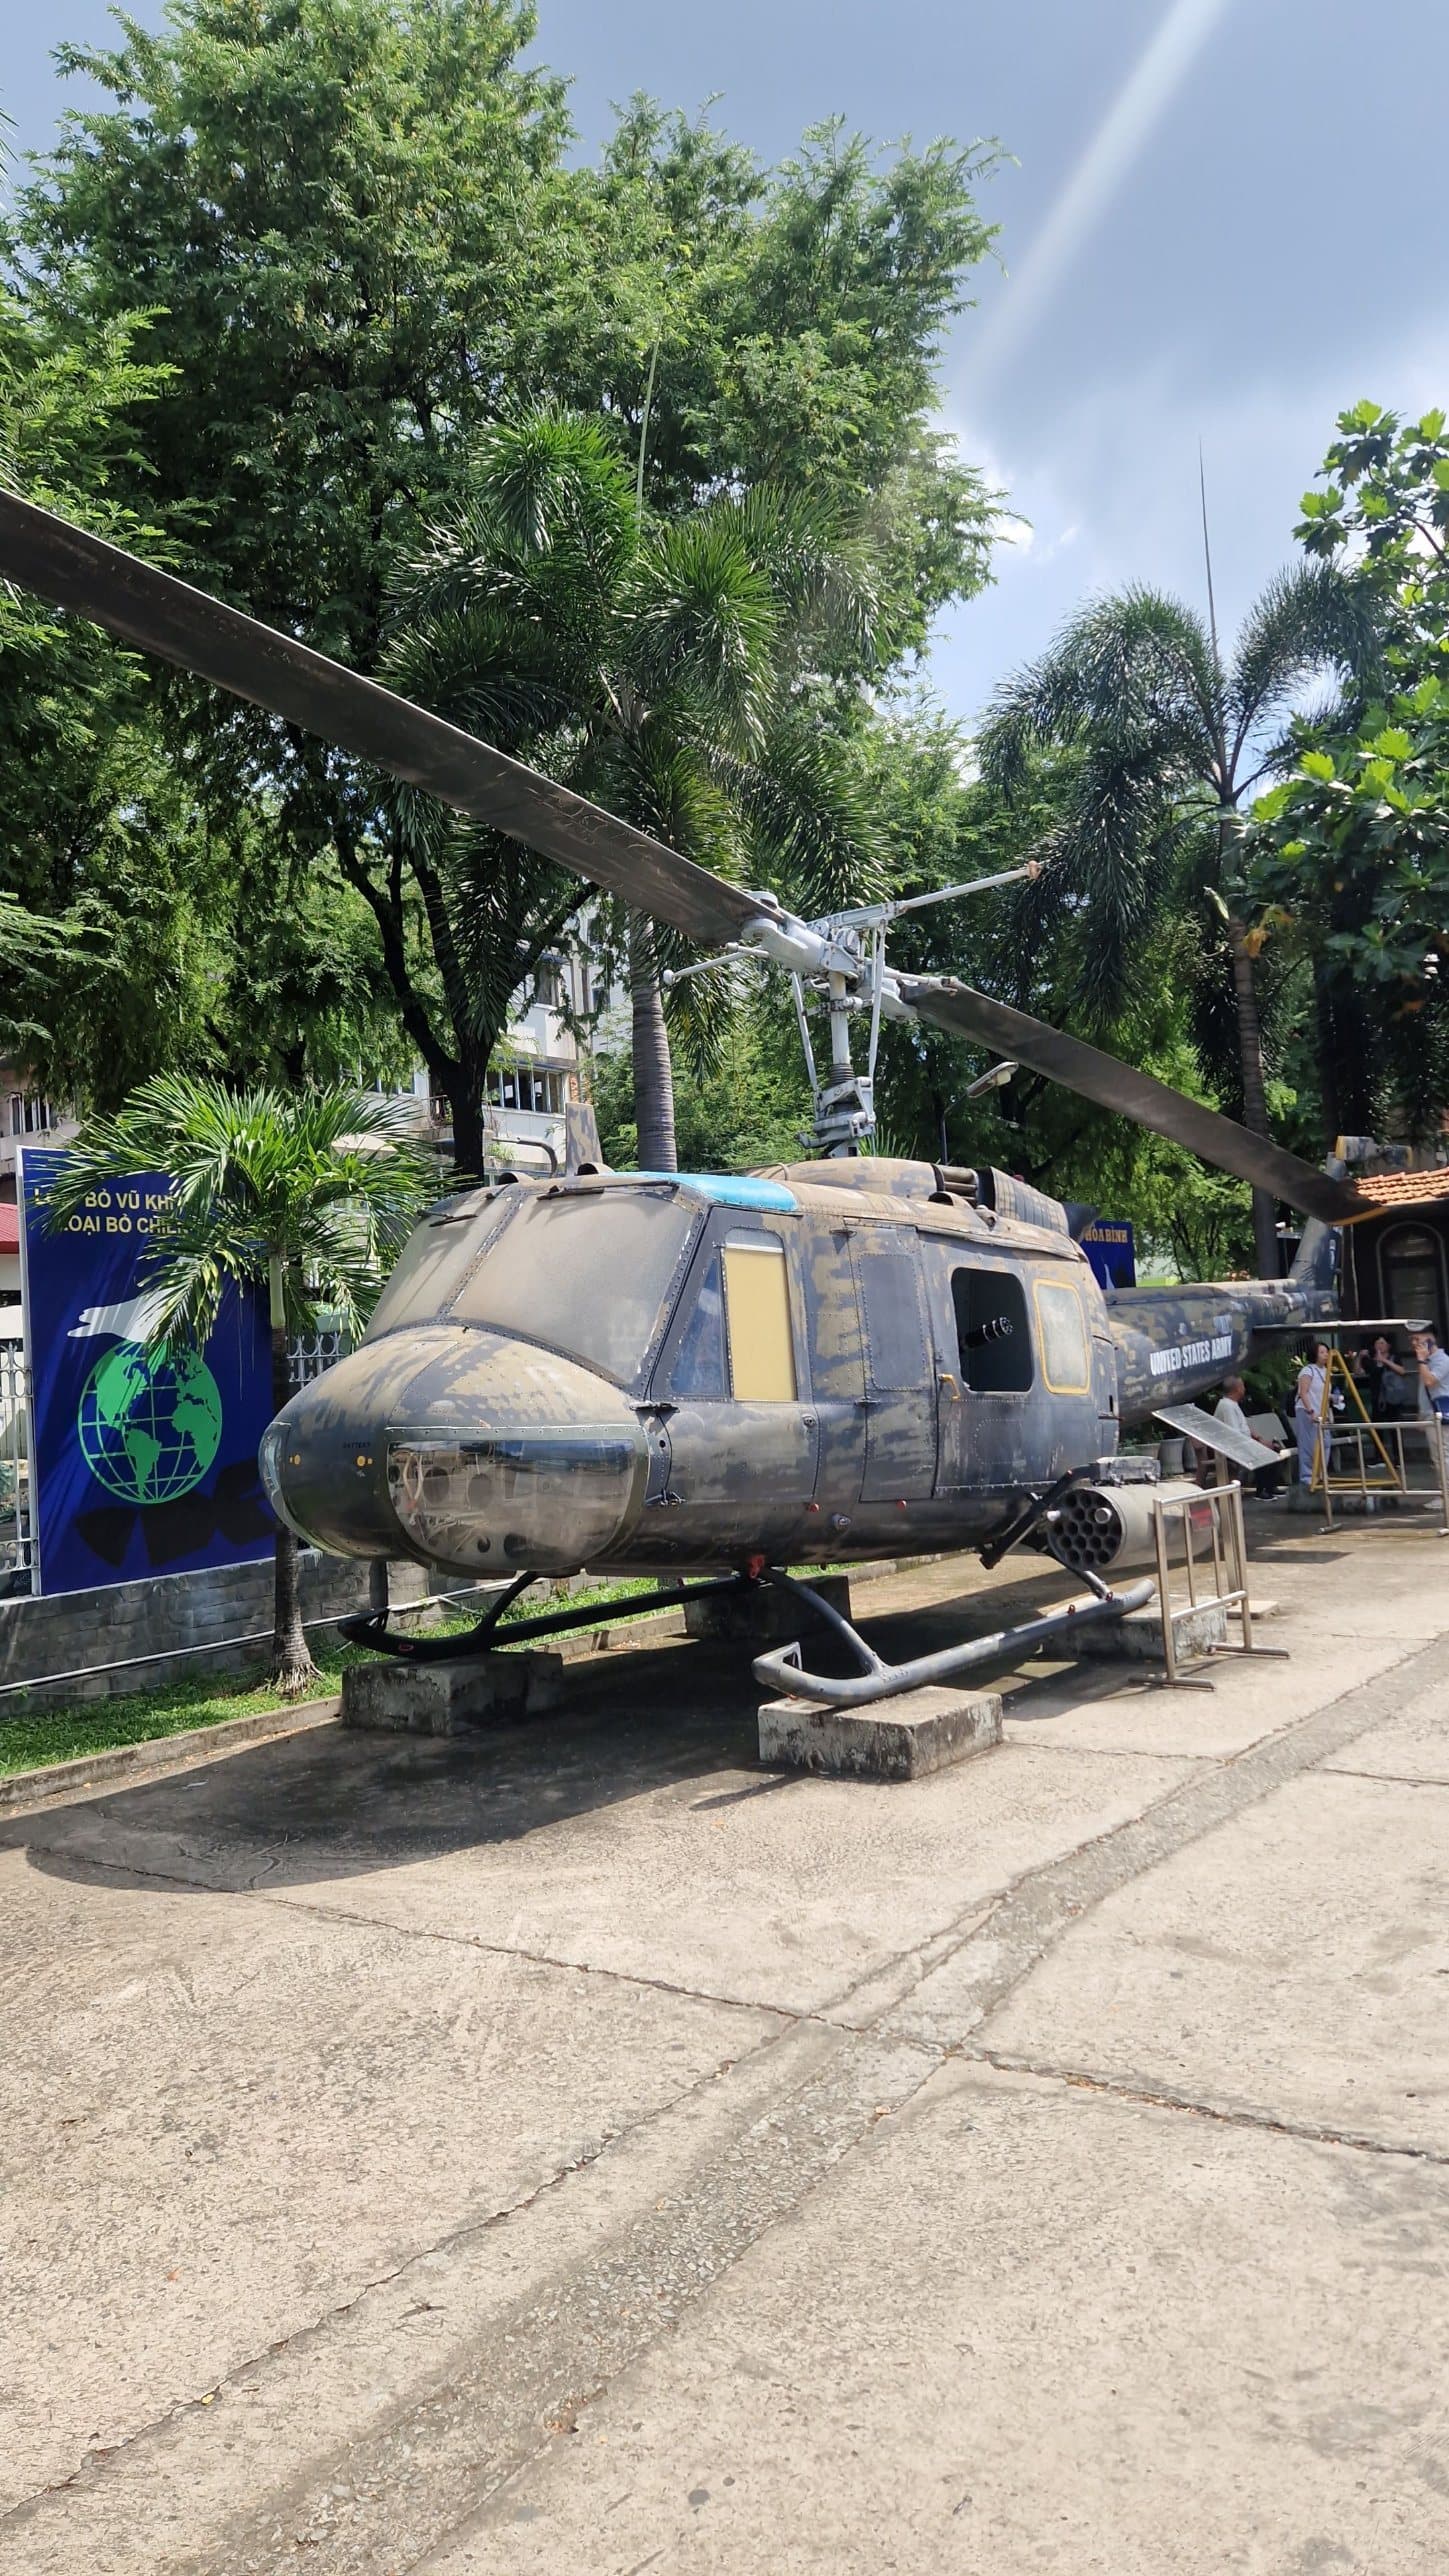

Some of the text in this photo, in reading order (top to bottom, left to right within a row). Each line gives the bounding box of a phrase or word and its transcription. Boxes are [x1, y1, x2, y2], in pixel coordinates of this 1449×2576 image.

[85, 1188, 111, 1209] BỎ
[116, 1190, 140, 1210] VŨ
[64, 1215, 100, 1236] OẠI
[106, 1213, 132, 1233] BỎ
[1150, 1335, 1232, 1376] UNITED STATES ARMY
